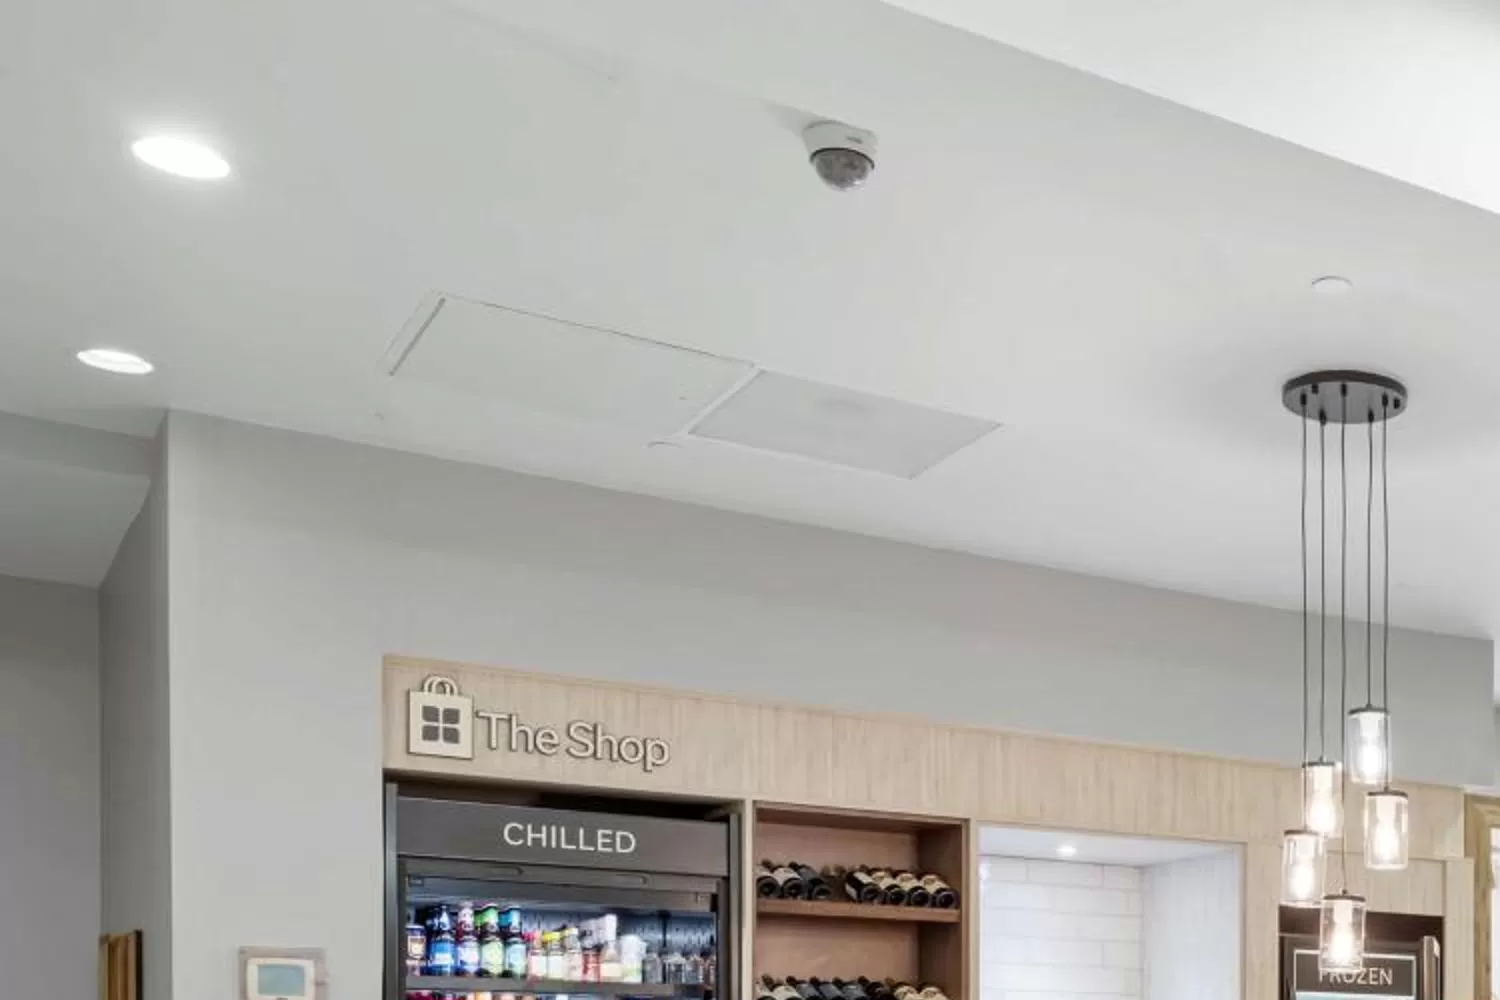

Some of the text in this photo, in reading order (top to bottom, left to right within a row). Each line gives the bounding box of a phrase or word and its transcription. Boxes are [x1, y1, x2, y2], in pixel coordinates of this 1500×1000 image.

[475, 710, 671, 773] The Shop
[503, 822, 637, 854] CHILLED
[1319, 966, 1393, 986] FROZEN
